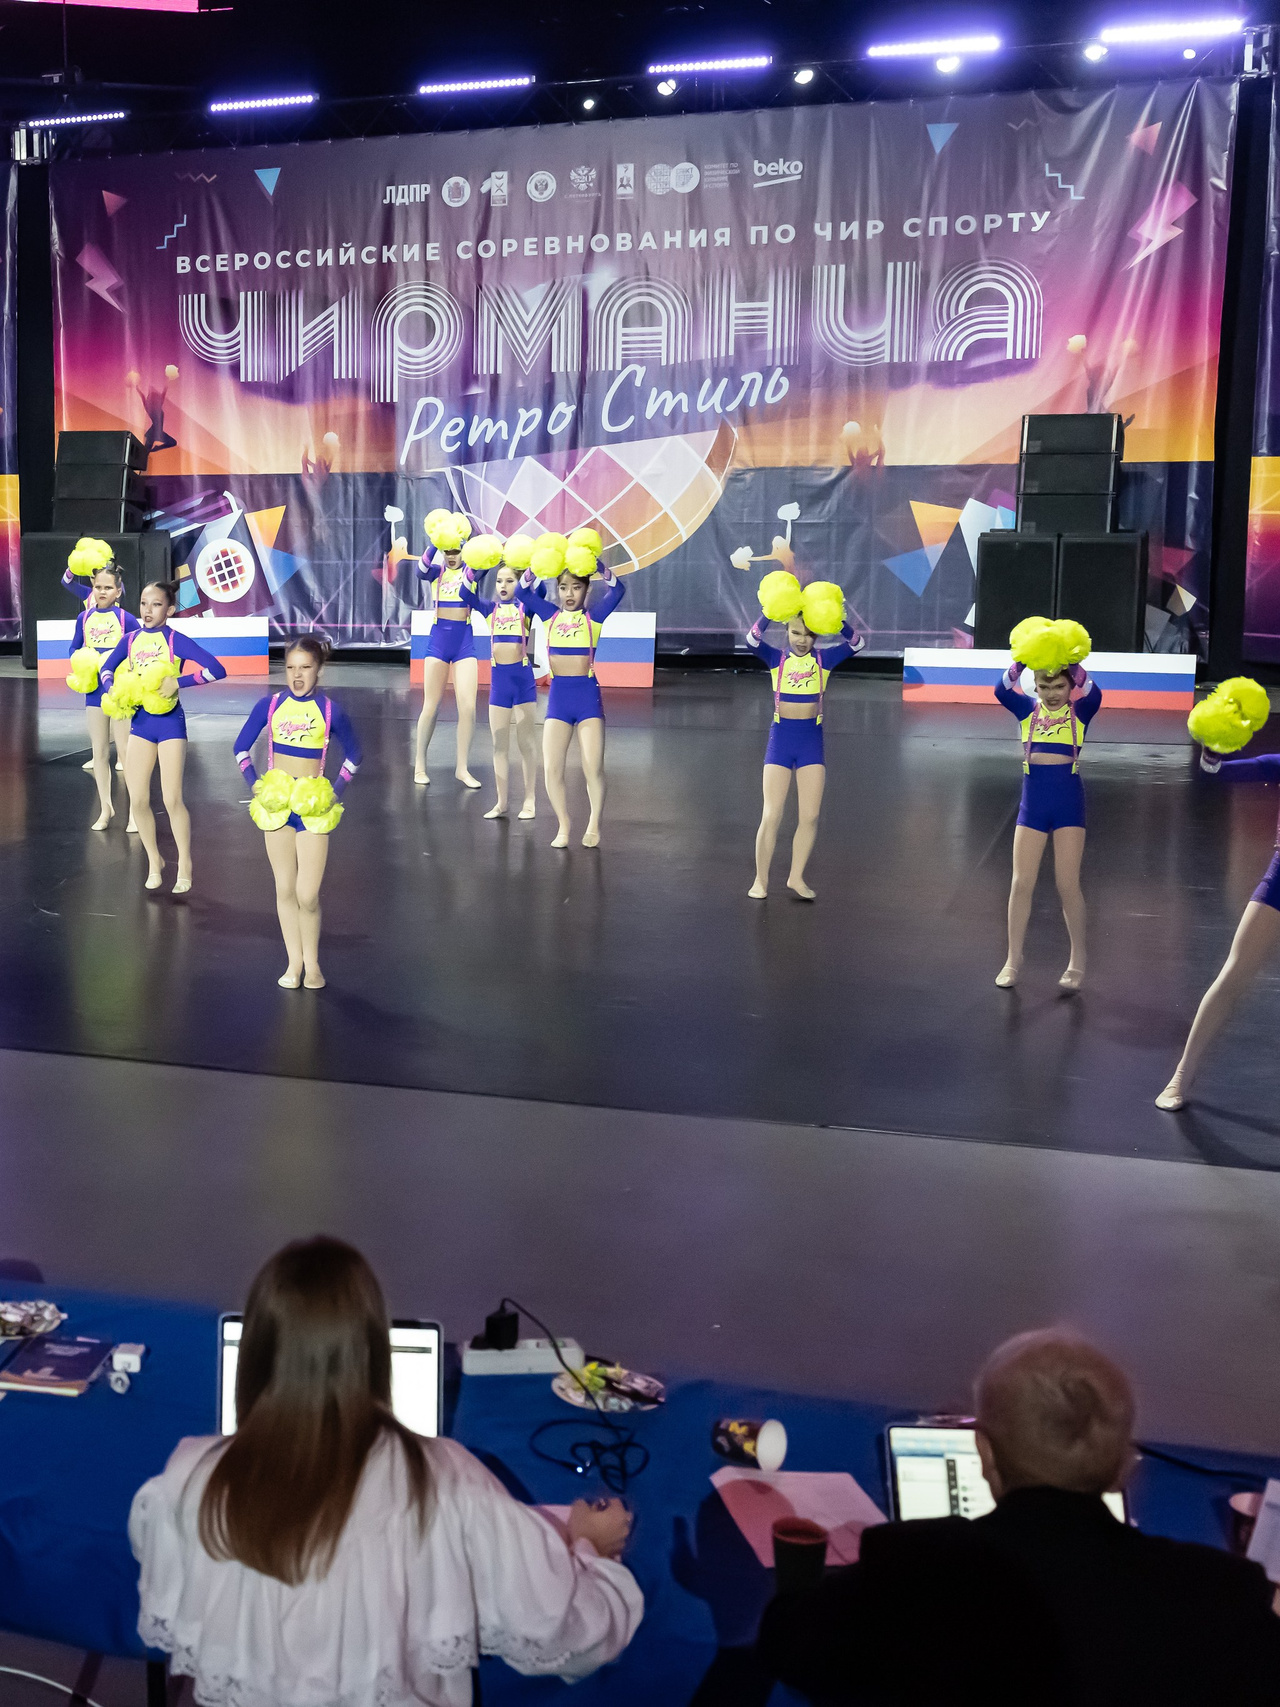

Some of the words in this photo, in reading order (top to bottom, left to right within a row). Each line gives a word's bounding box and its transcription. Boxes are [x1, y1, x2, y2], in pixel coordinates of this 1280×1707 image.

[753, 158, 804, 176] beko
[382, 183, 431, 206] ЛДПР
[176, 242, 441, 275] ВСЕРОССИЙСКИЕ
[456, 227, 732, 260] СОРЕВНОВАНИЯ
[749, 224, 797, 245] ПО
[814, 219, 885, 242] ЧИР
[902, 211, 1051, 238] СПОРТУ
[399, 396, 577, 466] Ретро
[601, 363, 791, 433] Стиль
